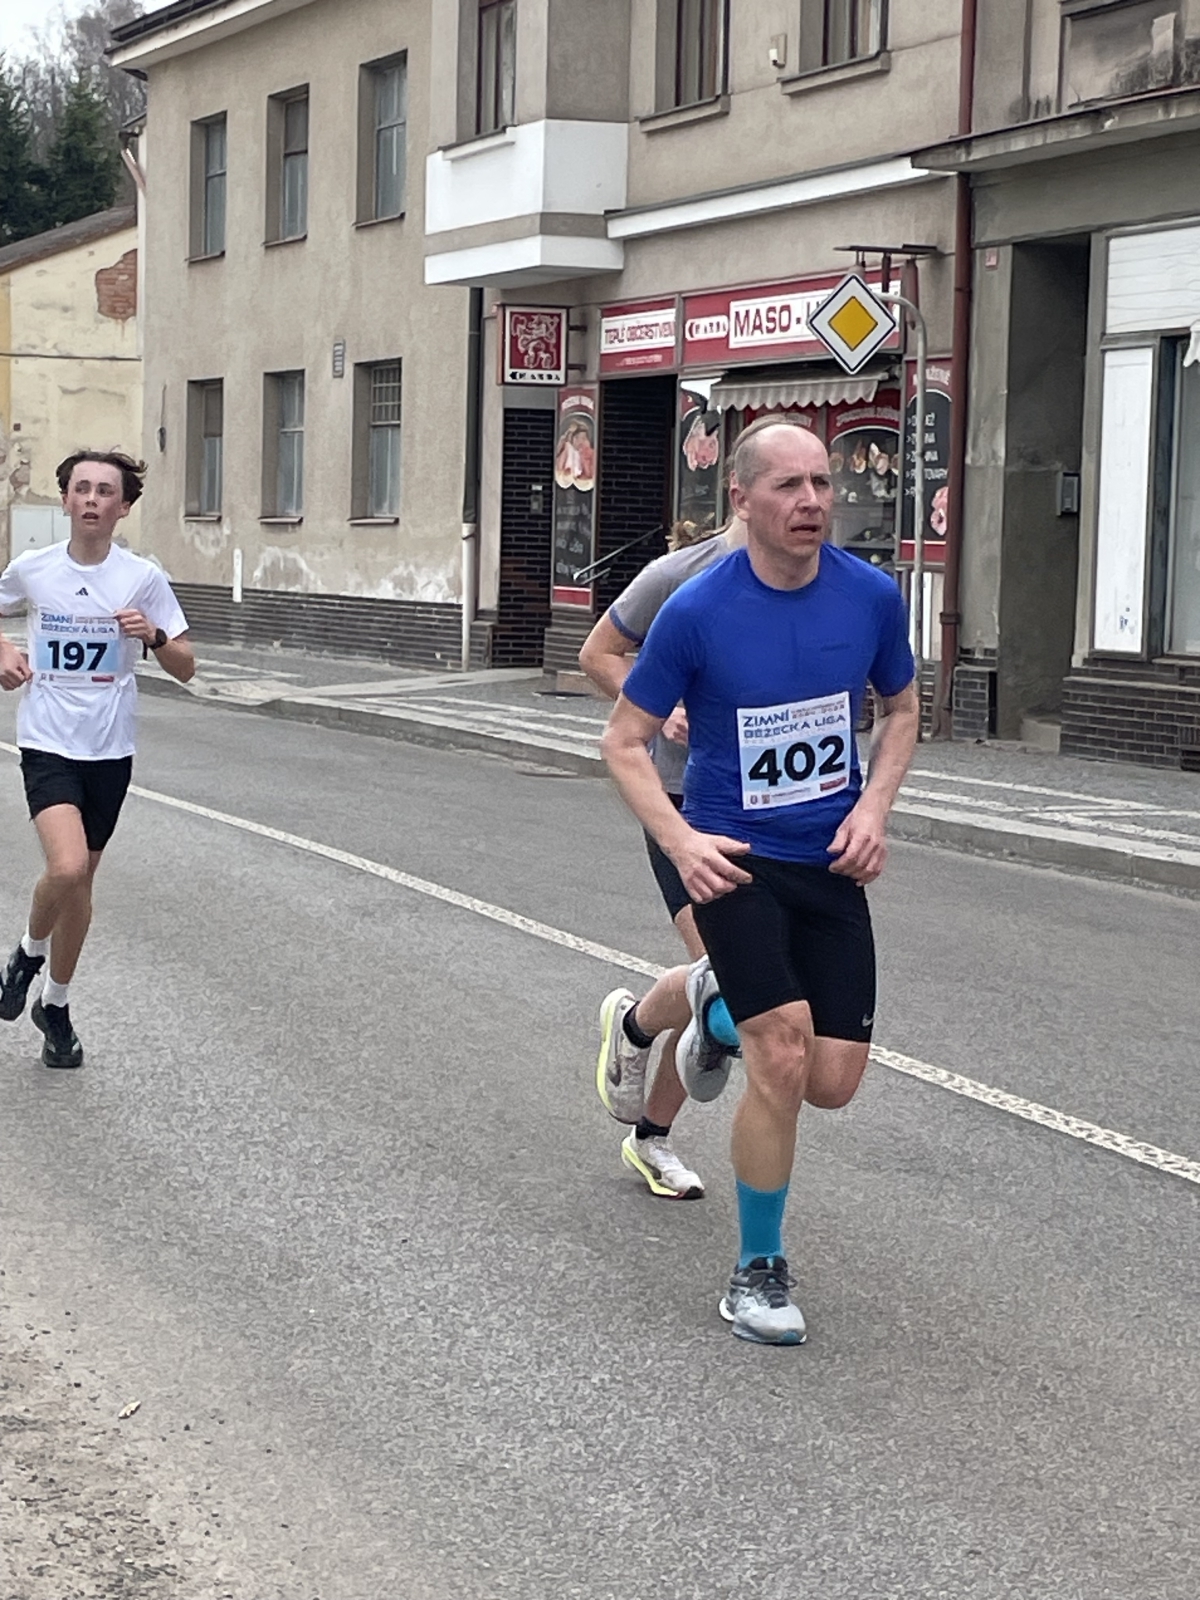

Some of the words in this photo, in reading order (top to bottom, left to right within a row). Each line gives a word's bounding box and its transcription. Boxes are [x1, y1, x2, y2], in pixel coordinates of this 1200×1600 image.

[734, 304, 791, 338] MASO
[47, 640, 108, 672] 197
[743, 708, 790, 728] ZIMNÍ
[814, 713, 846, 727] LIGA
[748, 735, 845, 787] 402
